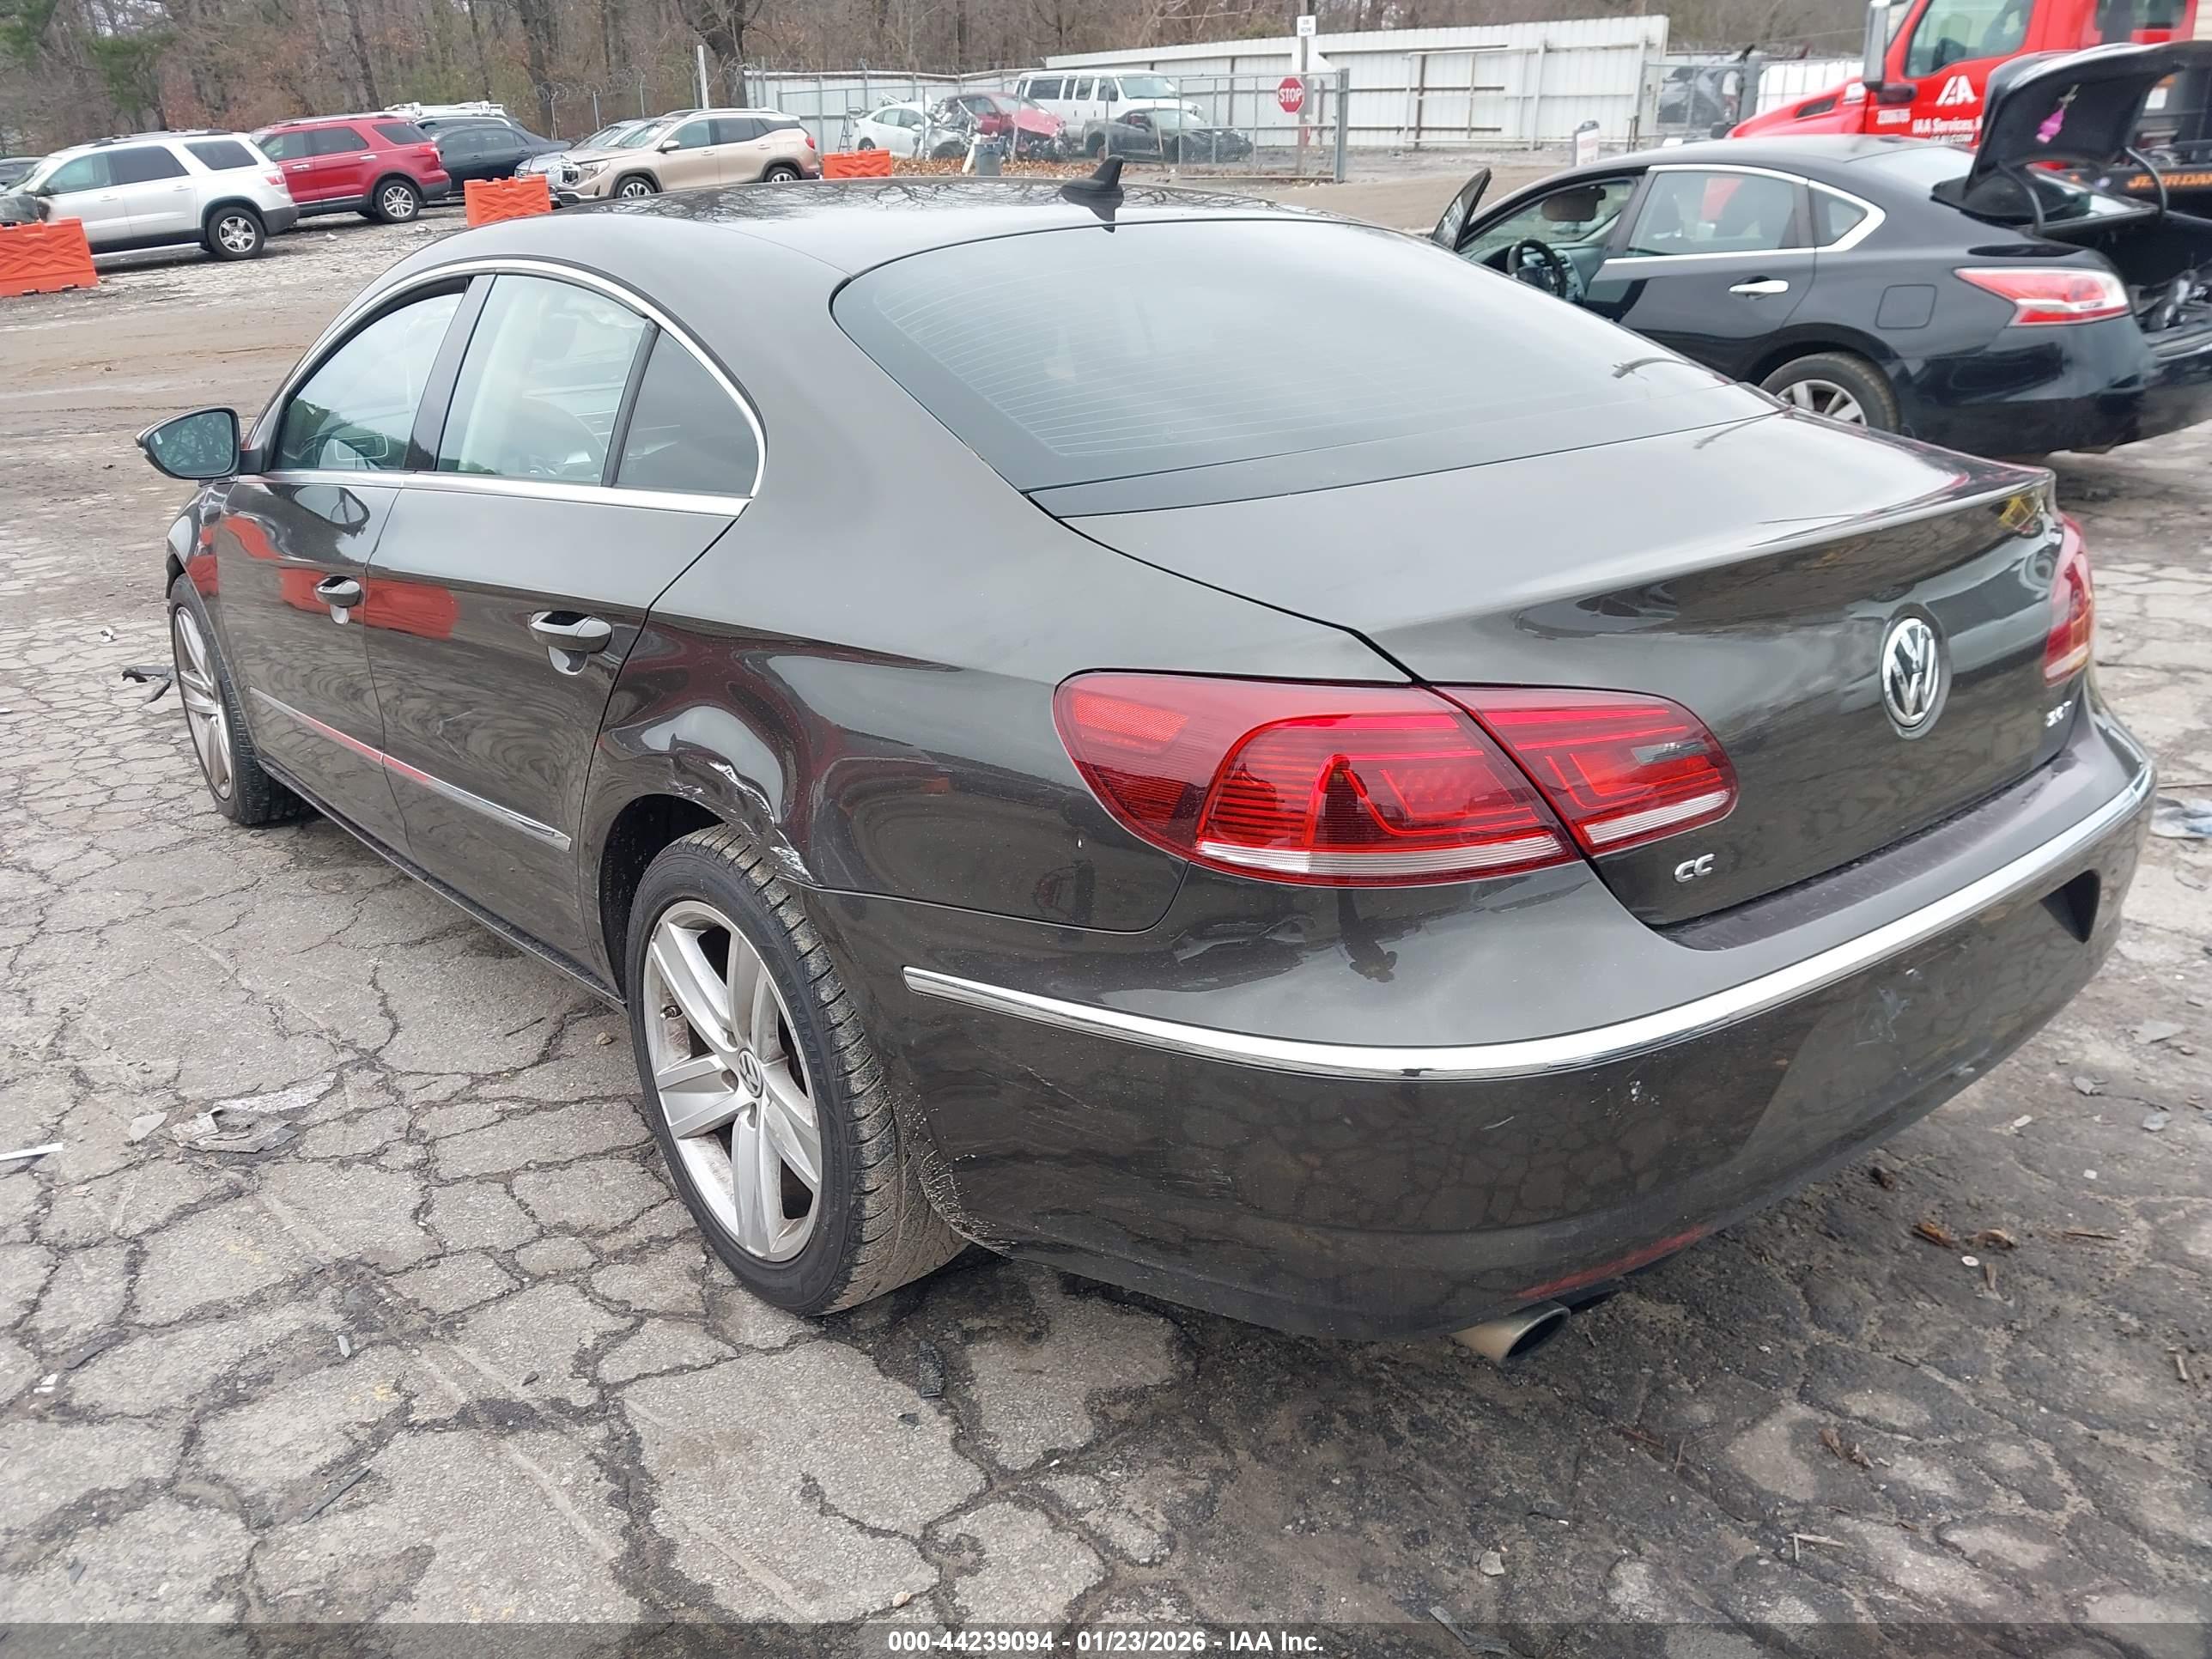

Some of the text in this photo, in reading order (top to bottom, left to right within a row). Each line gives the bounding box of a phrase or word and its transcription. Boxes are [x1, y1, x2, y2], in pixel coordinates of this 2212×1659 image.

[1279, 88, 1302, 102] STOP
[1674, 853, 1716, 883] CC
[775, 965, 825, 1085] SUMMIT
